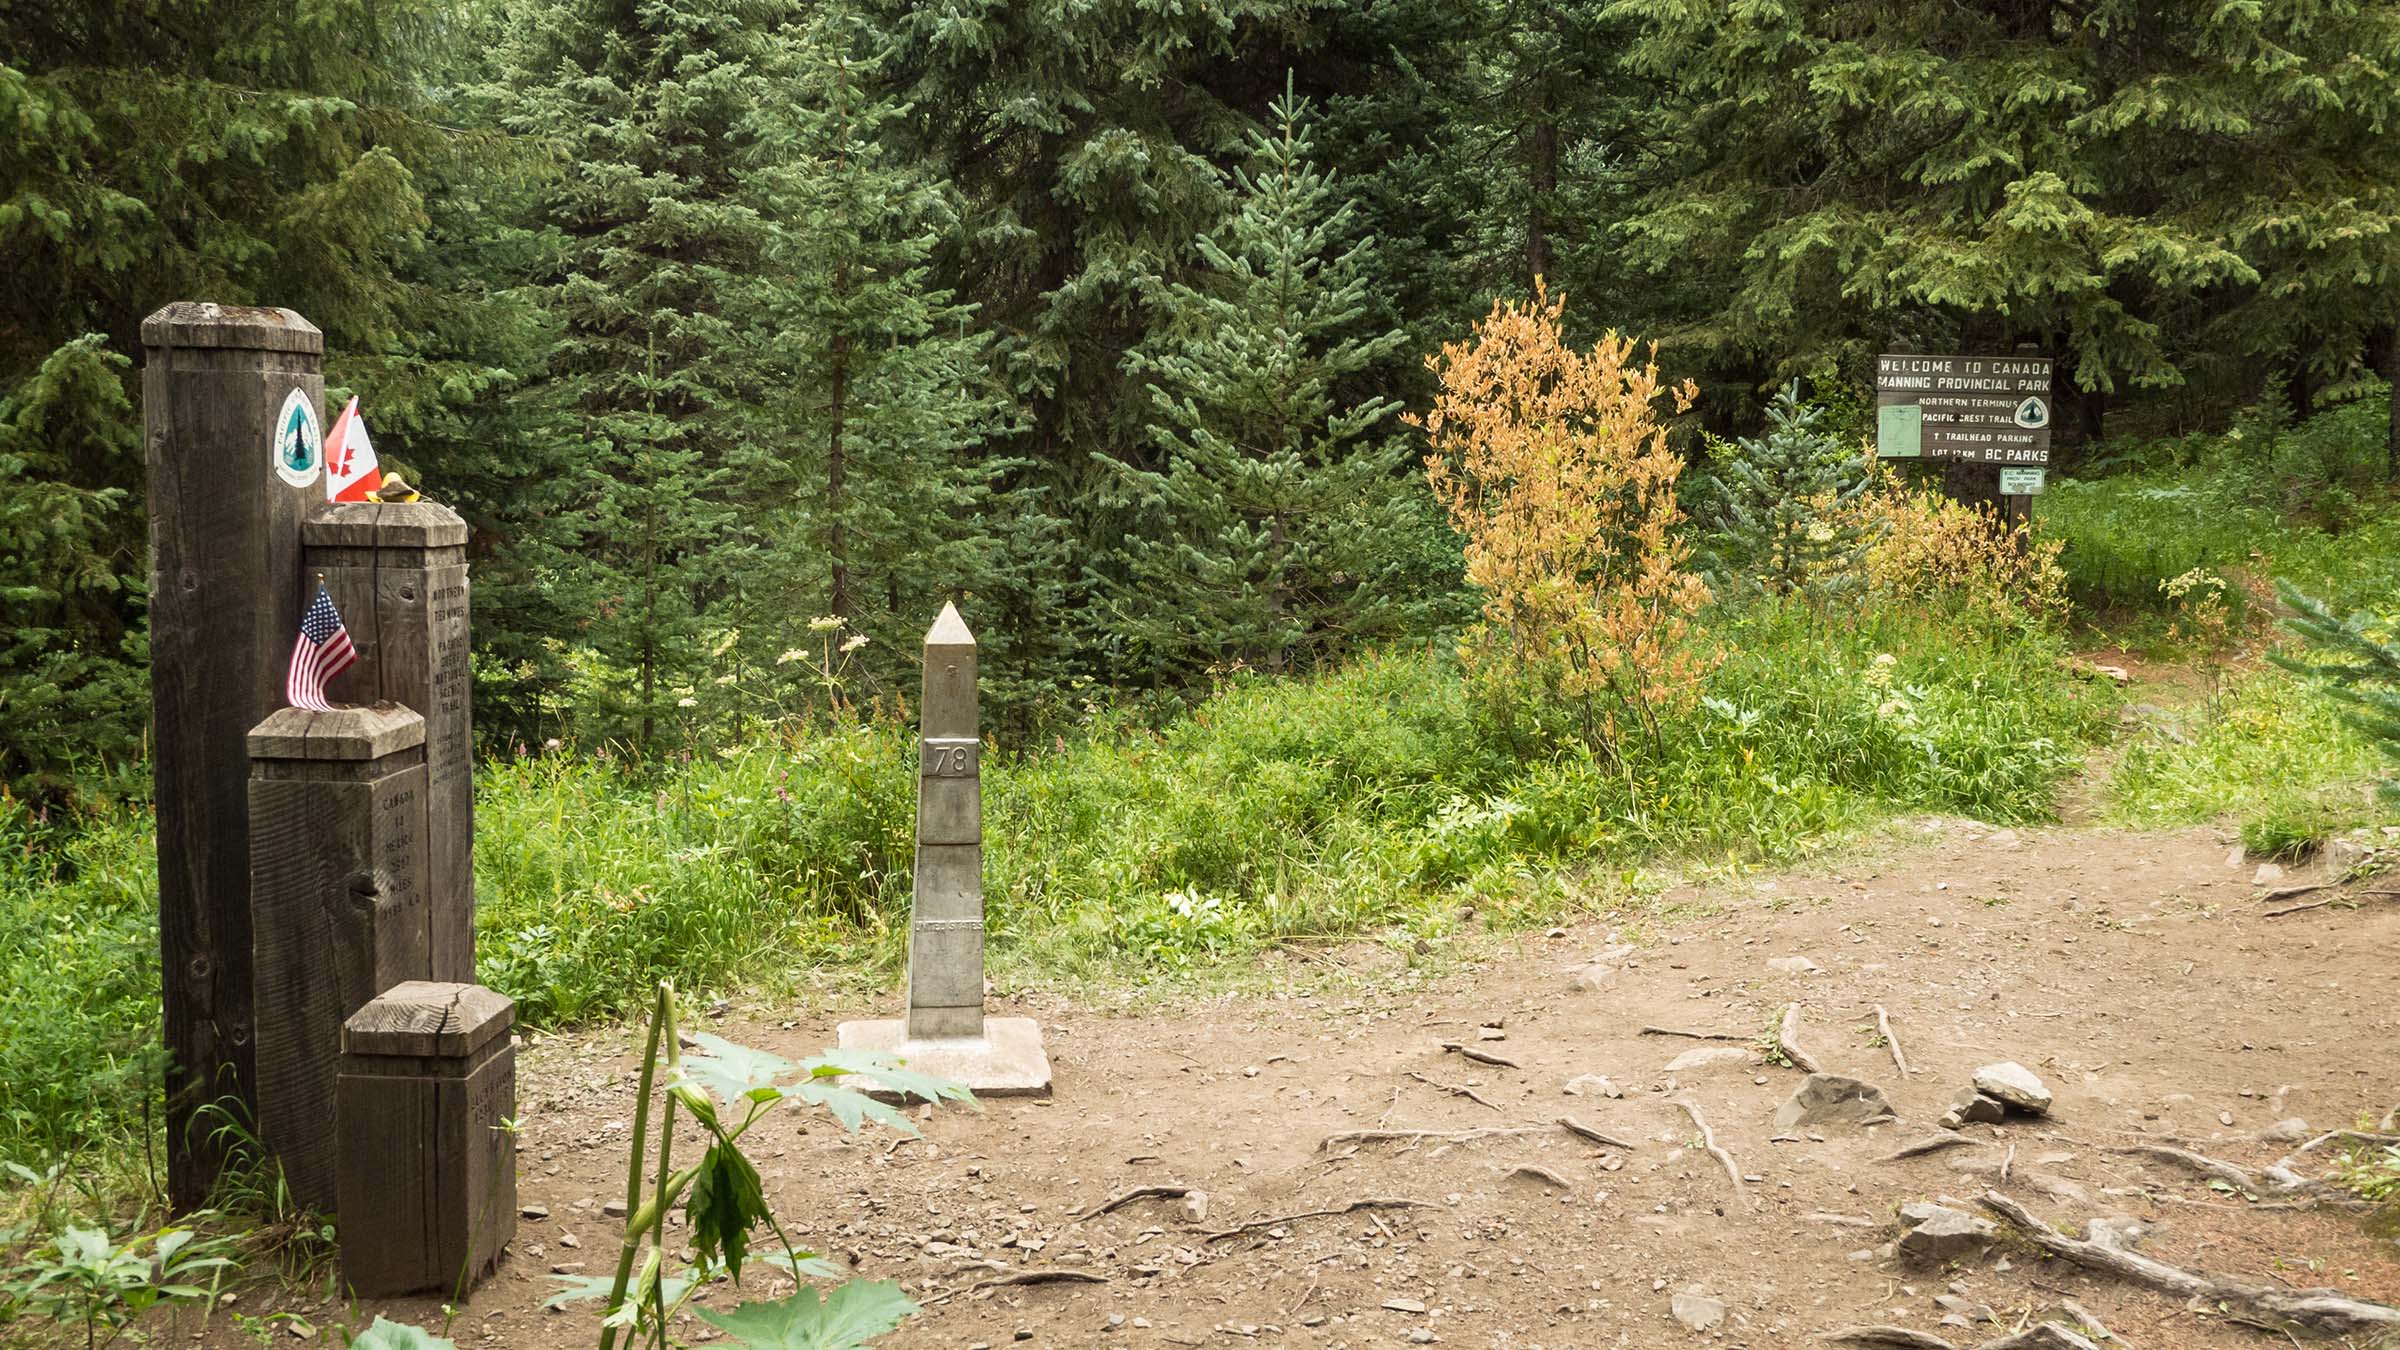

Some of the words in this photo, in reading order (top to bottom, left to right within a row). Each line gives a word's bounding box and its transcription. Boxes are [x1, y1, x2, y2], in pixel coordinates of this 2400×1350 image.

[1880, 360, 1952, 373] WELCOME
[1965, 361, 1982, 373] TO
[1992, 362, 2050, 375] CANADA
[1878, 376, 1931, 389] MANNING
[1937, 377, 2011, 391] PROVINCIAL
[2017, 380, 2049, 391] PARK
[1919, 397, 1968, 407] NORTHERN
[1971, 398, 2018, 409] TERMINUS
[1922, 413, 1955, 422] PACIFIC
[1989, 415, 2013, 424] TRAIL
[1946, 432, 1992, 442] TRAILHEAD
[1985, 448, 2002, 460] BC
[2006, 449, 2048, 462] PARKS
[934, 746, 967, 773] 78
